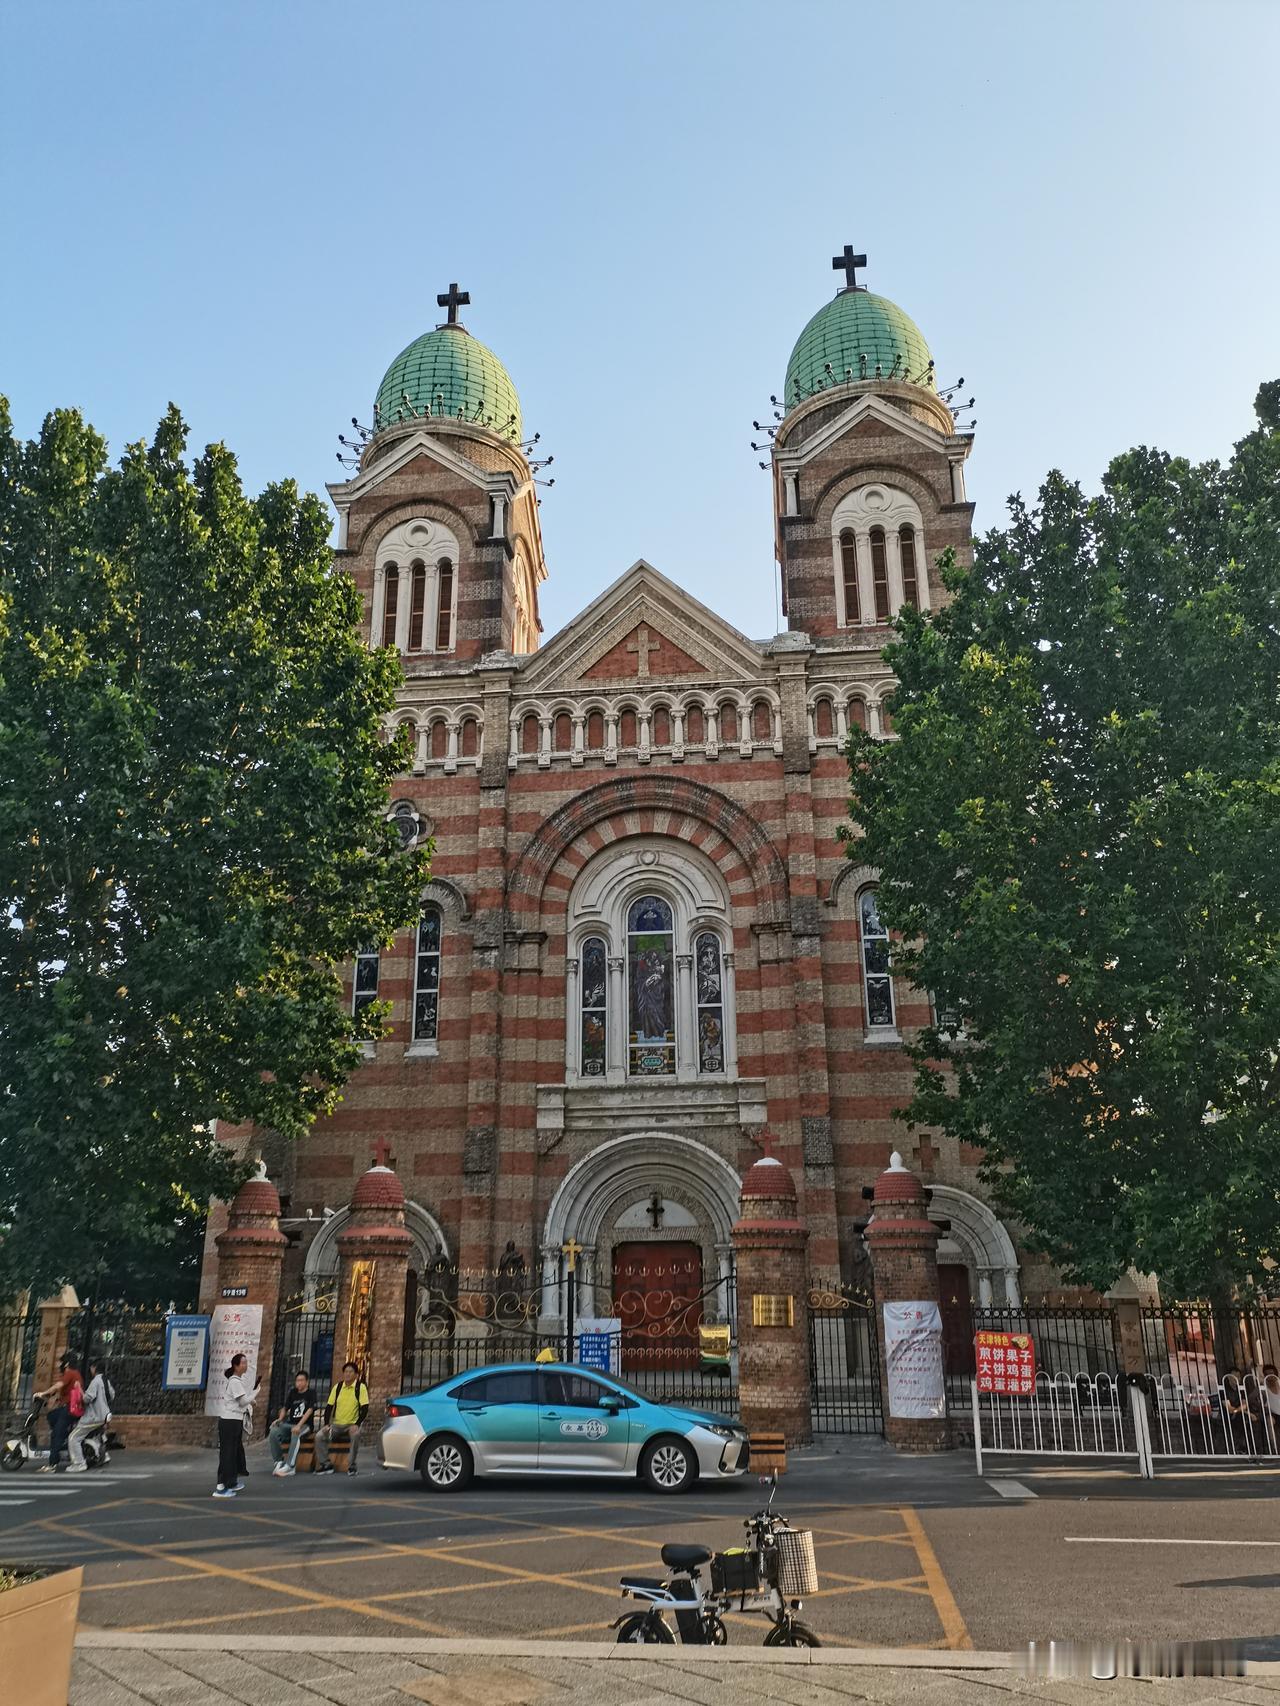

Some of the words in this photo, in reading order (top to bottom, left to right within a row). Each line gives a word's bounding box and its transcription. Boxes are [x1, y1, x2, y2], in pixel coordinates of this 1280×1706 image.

[903, 1311, 923, 1320] 公告
[979, 1334, 1009, 1346] 天津特色
[979, 1346, 1032, 1363] 煎饼果子
[979, 1361, 1032, 1378] 大饼鸡蛋
[979, 1376, 1033, 1392] 鸡蛋灌饼
[586, 1424, 603, 1432] TAXI
